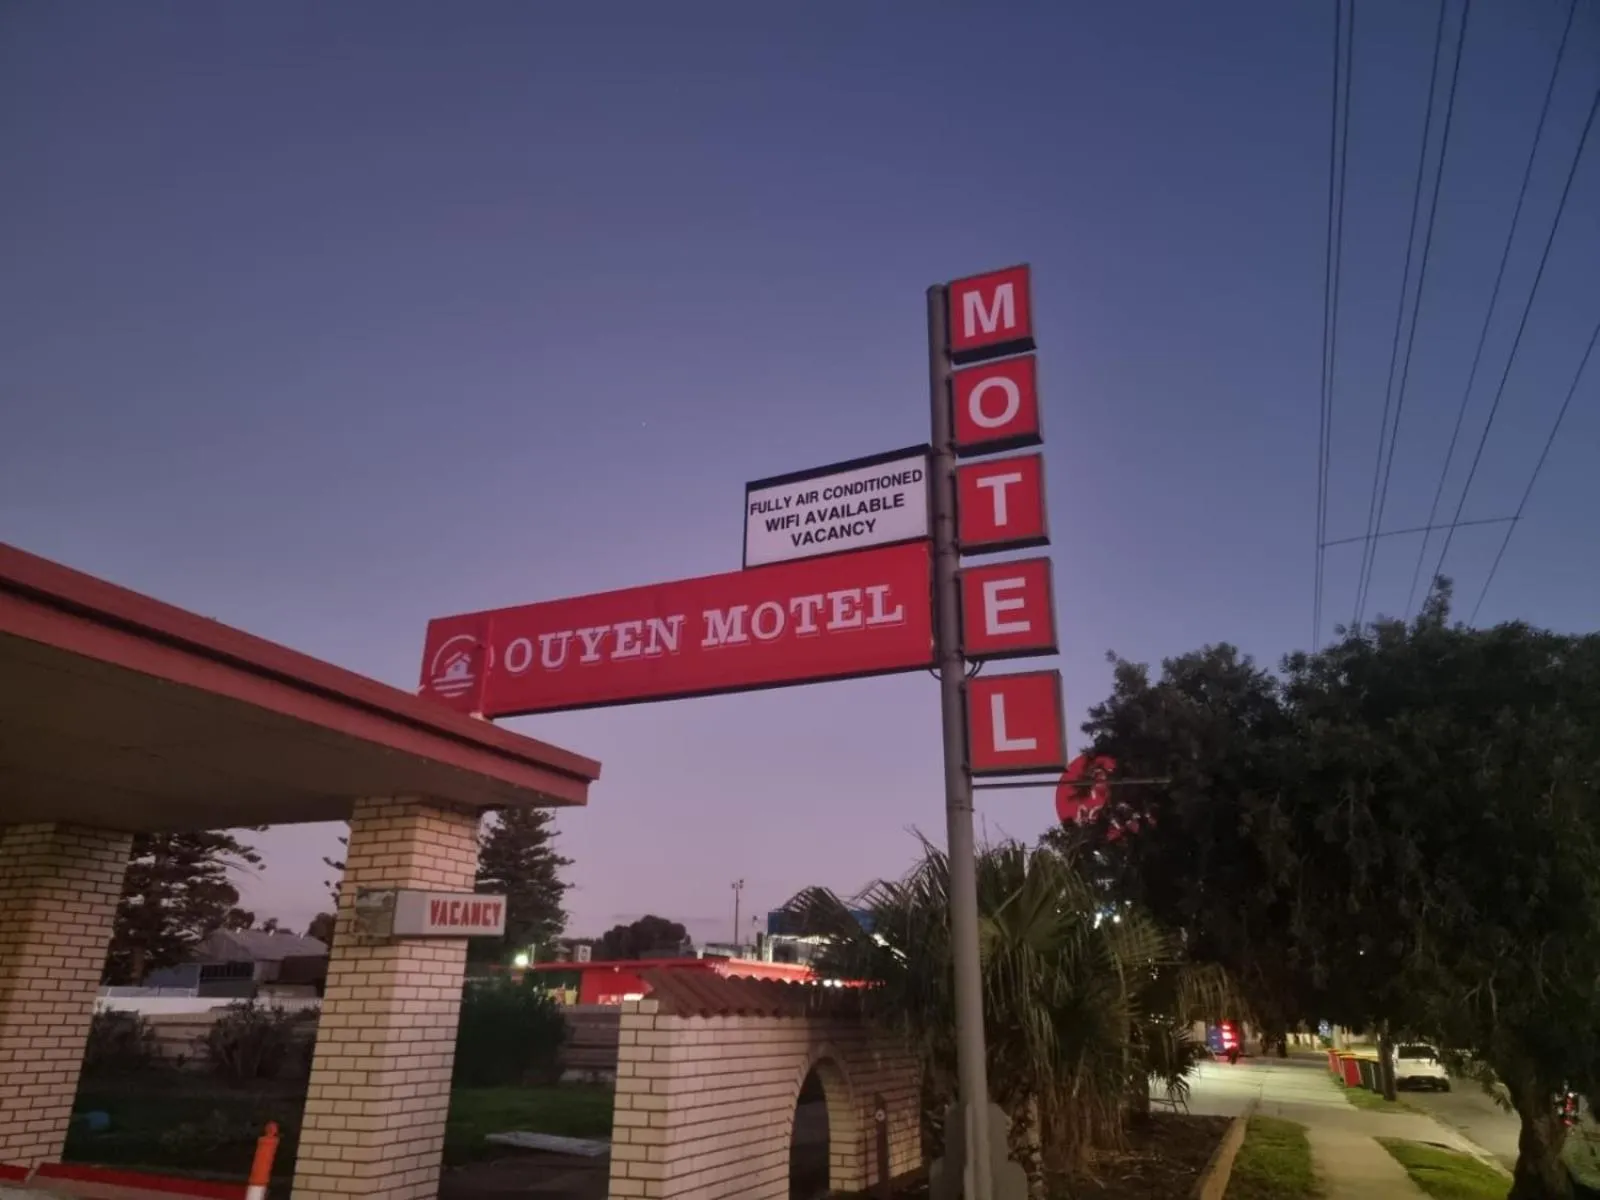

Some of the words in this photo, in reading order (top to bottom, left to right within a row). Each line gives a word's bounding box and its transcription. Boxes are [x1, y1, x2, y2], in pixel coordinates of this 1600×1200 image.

[750, 496, 792, 515] FULLY
[796, 490, 819, 506] AIR
[822, 470, 923, 499] CONDITIONED
[765, 513, 800, 532] WIFI
[804, 493, 905, 525] AVAILABLE
[791, 519, 876, 547] VACANCY
[962, 283, 1037, 752] MOTEL
[504, 615, 686, 673] OUYEN
[701, 584, 904, 648] MOTEL
[430, 899, 502, 926] VACANCY
